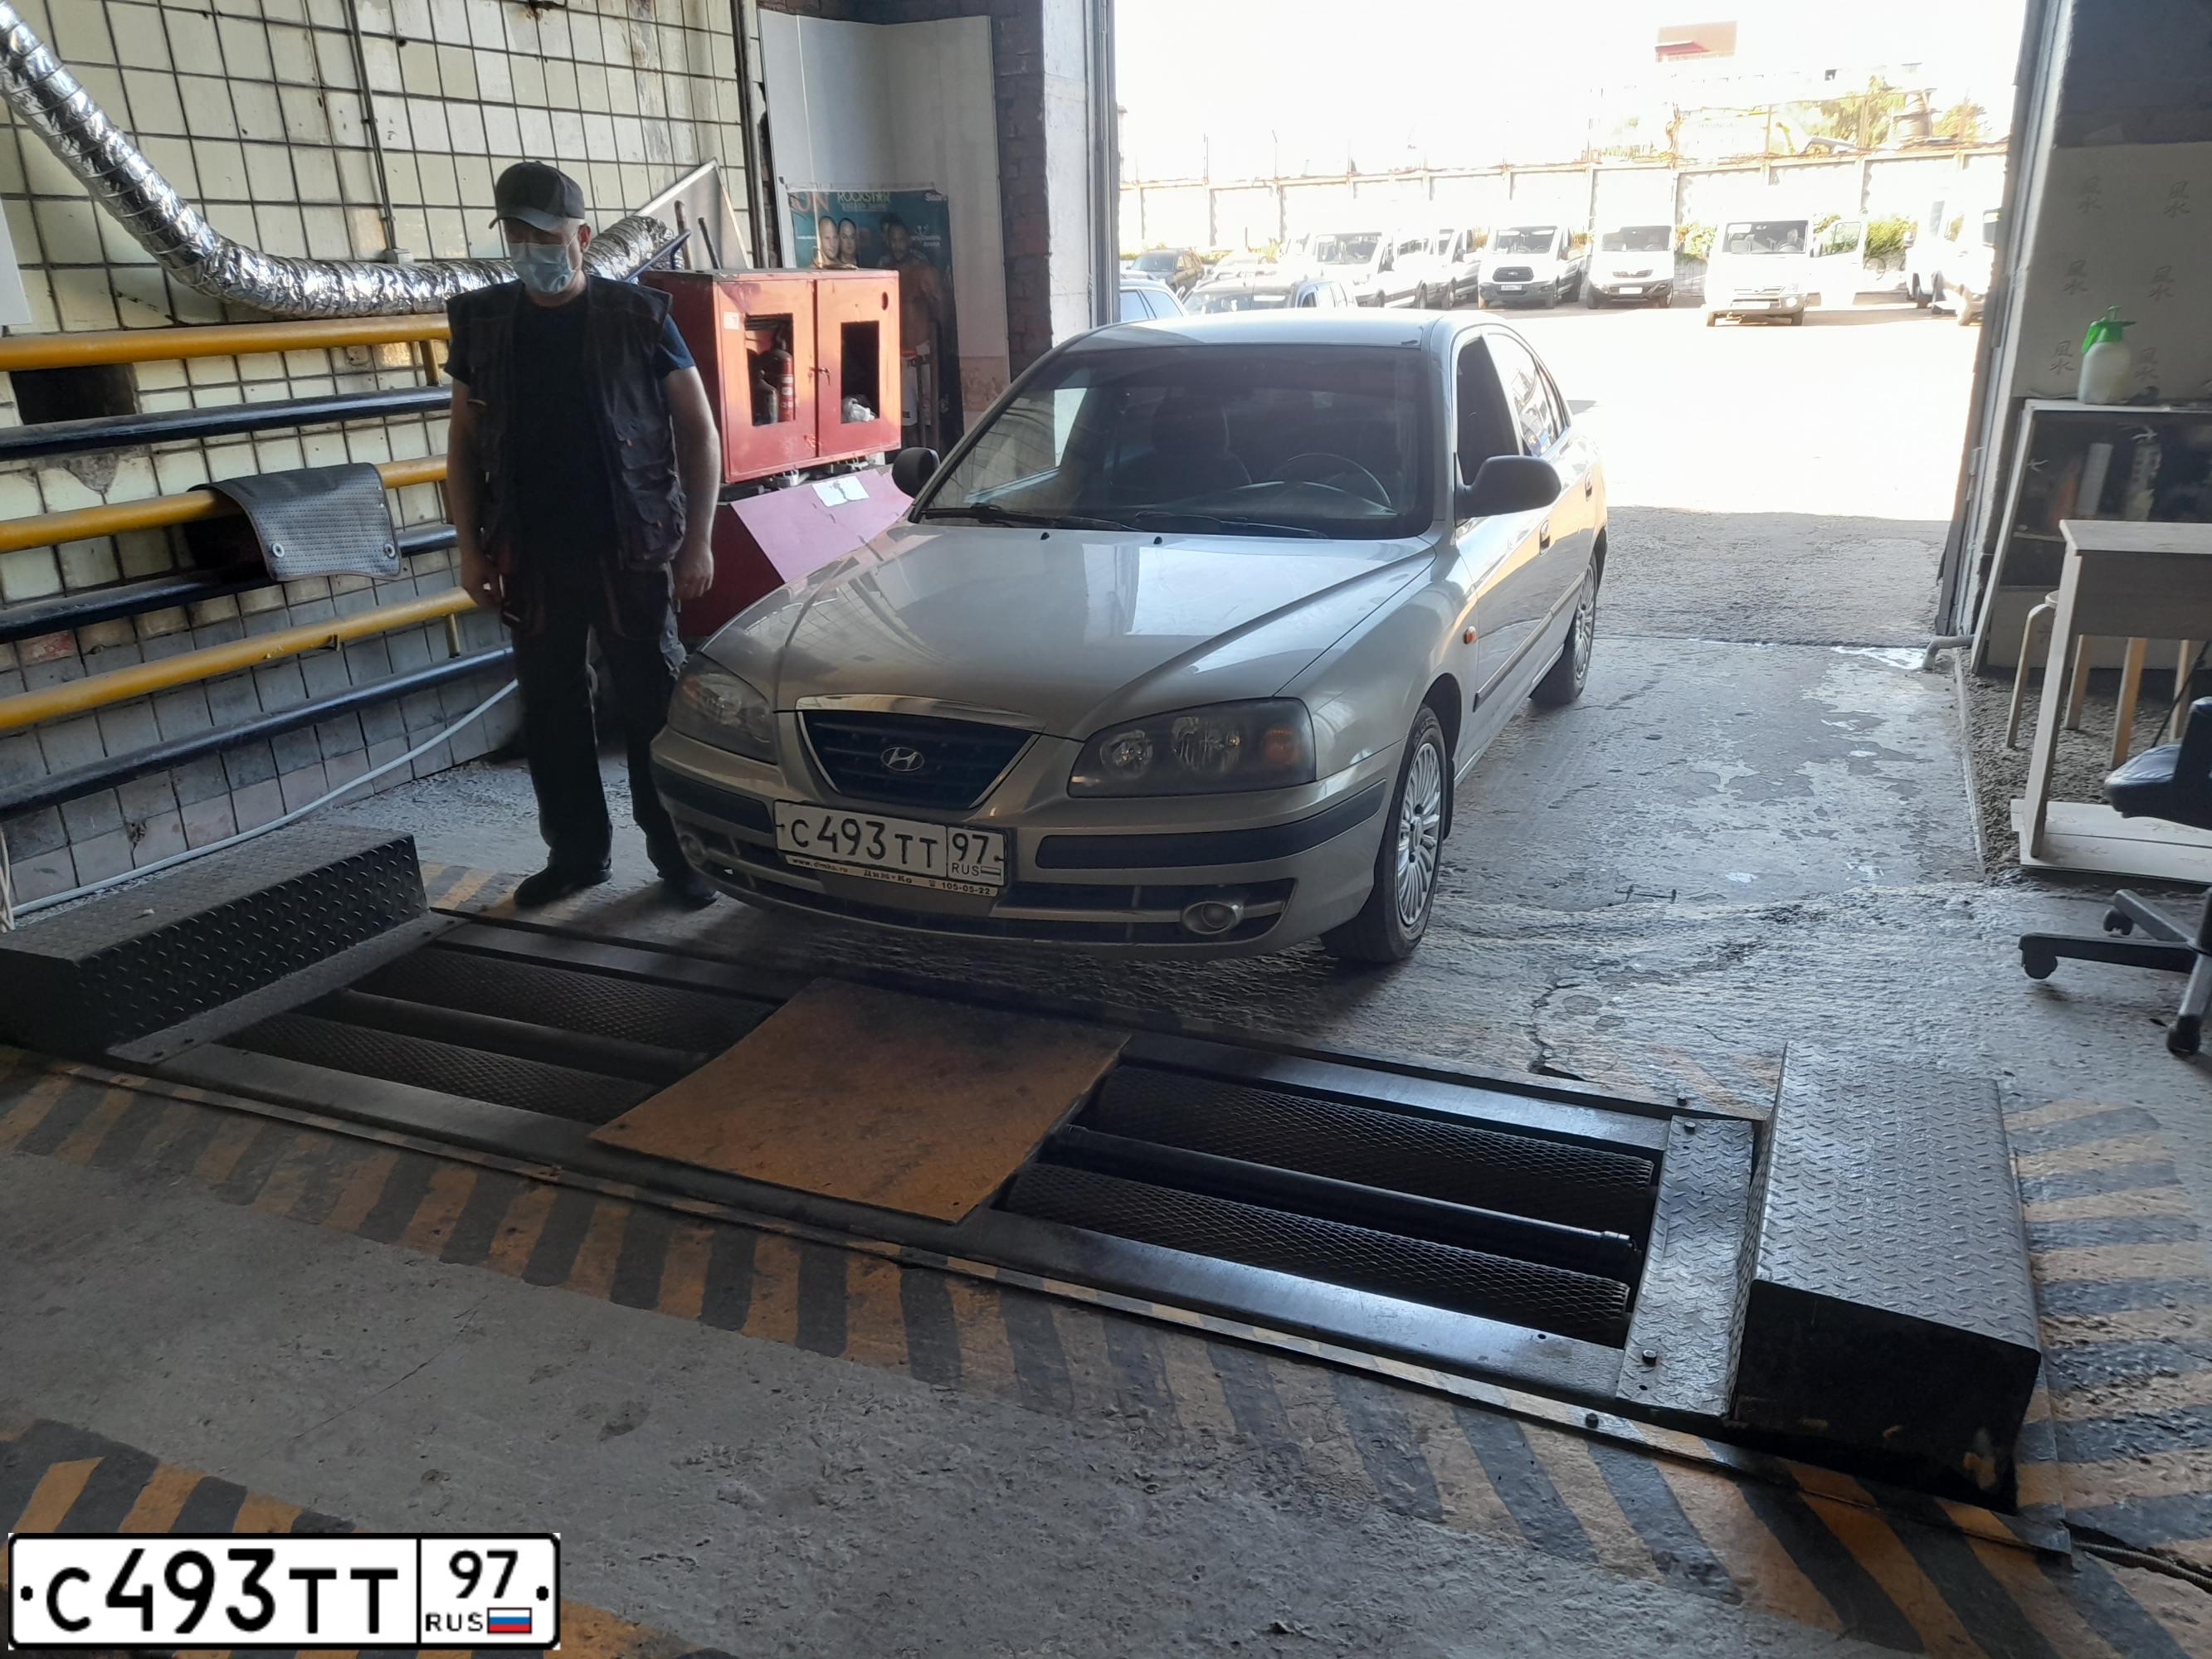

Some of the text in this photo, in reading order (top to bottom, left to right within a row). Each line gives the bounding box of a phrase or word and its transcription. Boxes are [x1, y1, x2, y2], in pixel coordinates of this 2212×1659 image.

[952, 832, 989, 864] 97
[952, 862, 980, 877] RUS
[942, 882, 991, 895] 105-05-22
